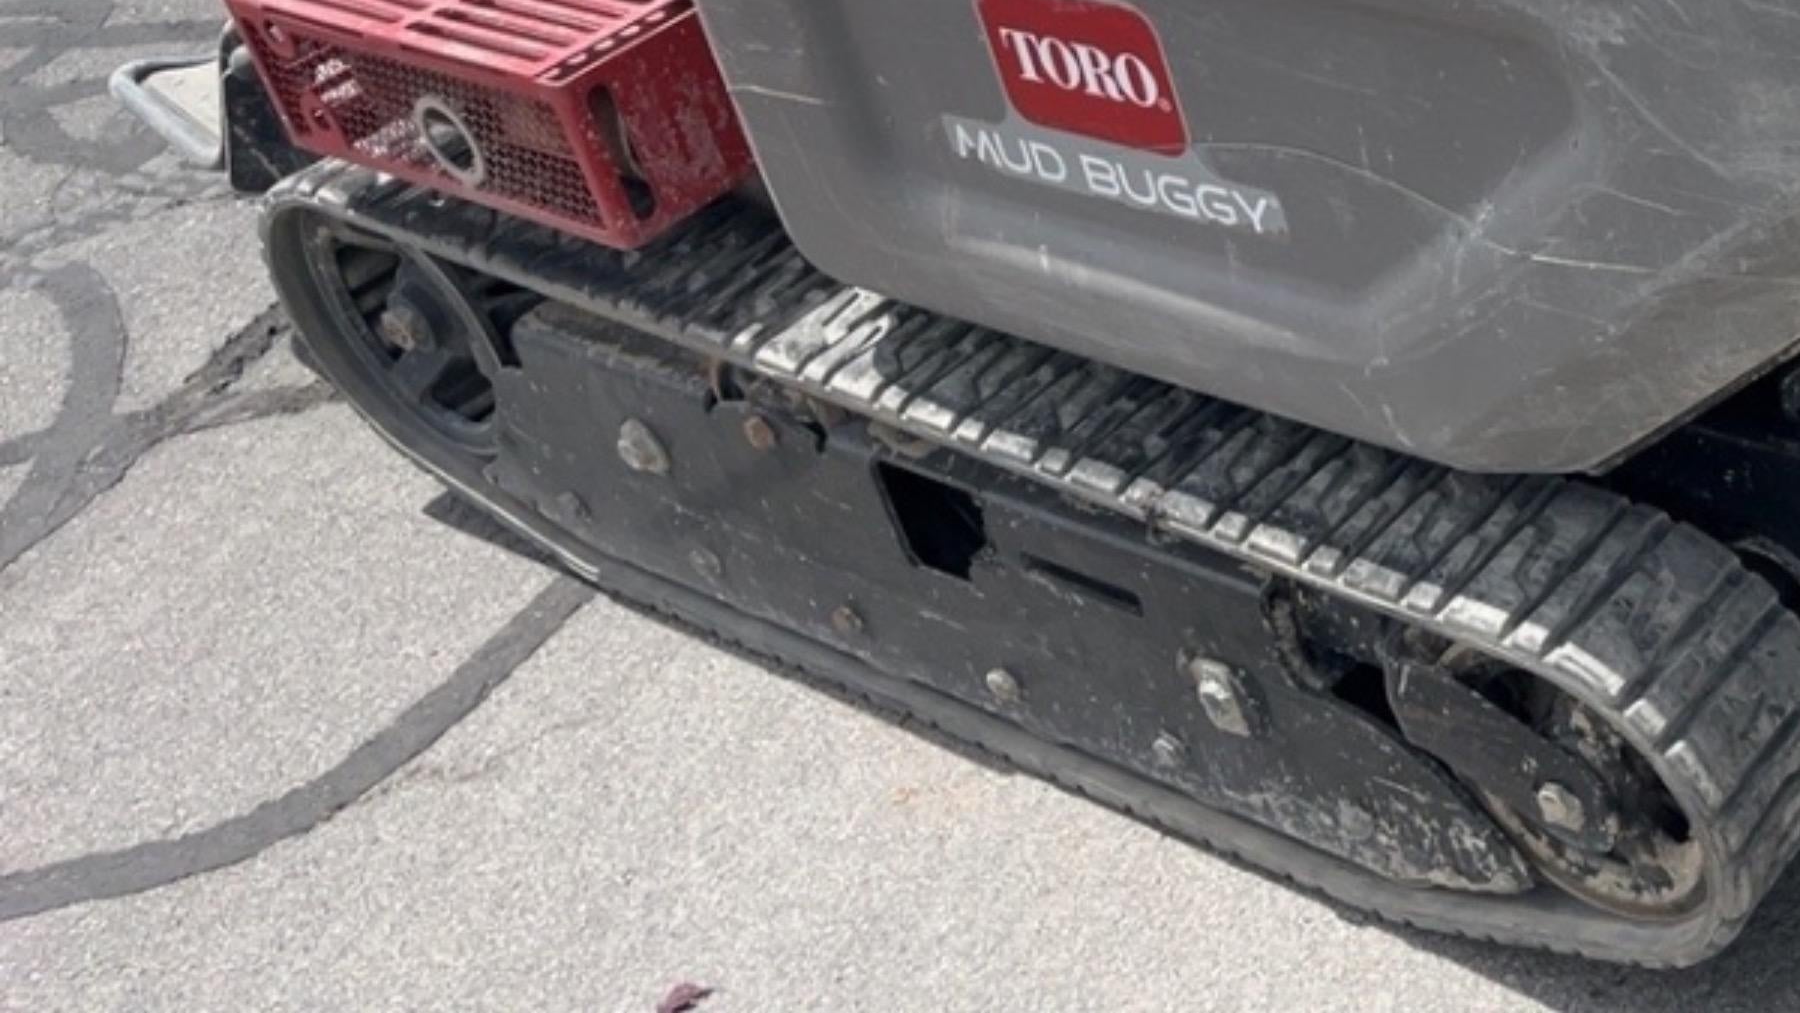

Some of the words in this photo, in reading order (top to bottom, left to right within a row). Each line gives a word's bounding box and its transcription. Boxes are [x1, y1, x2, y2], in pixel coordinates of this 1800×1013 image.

[999, 27, 1161, 110] TORO
[954, 123, 1067, 184] MUD
[1080, 155, 1272, 235] BUGGY
